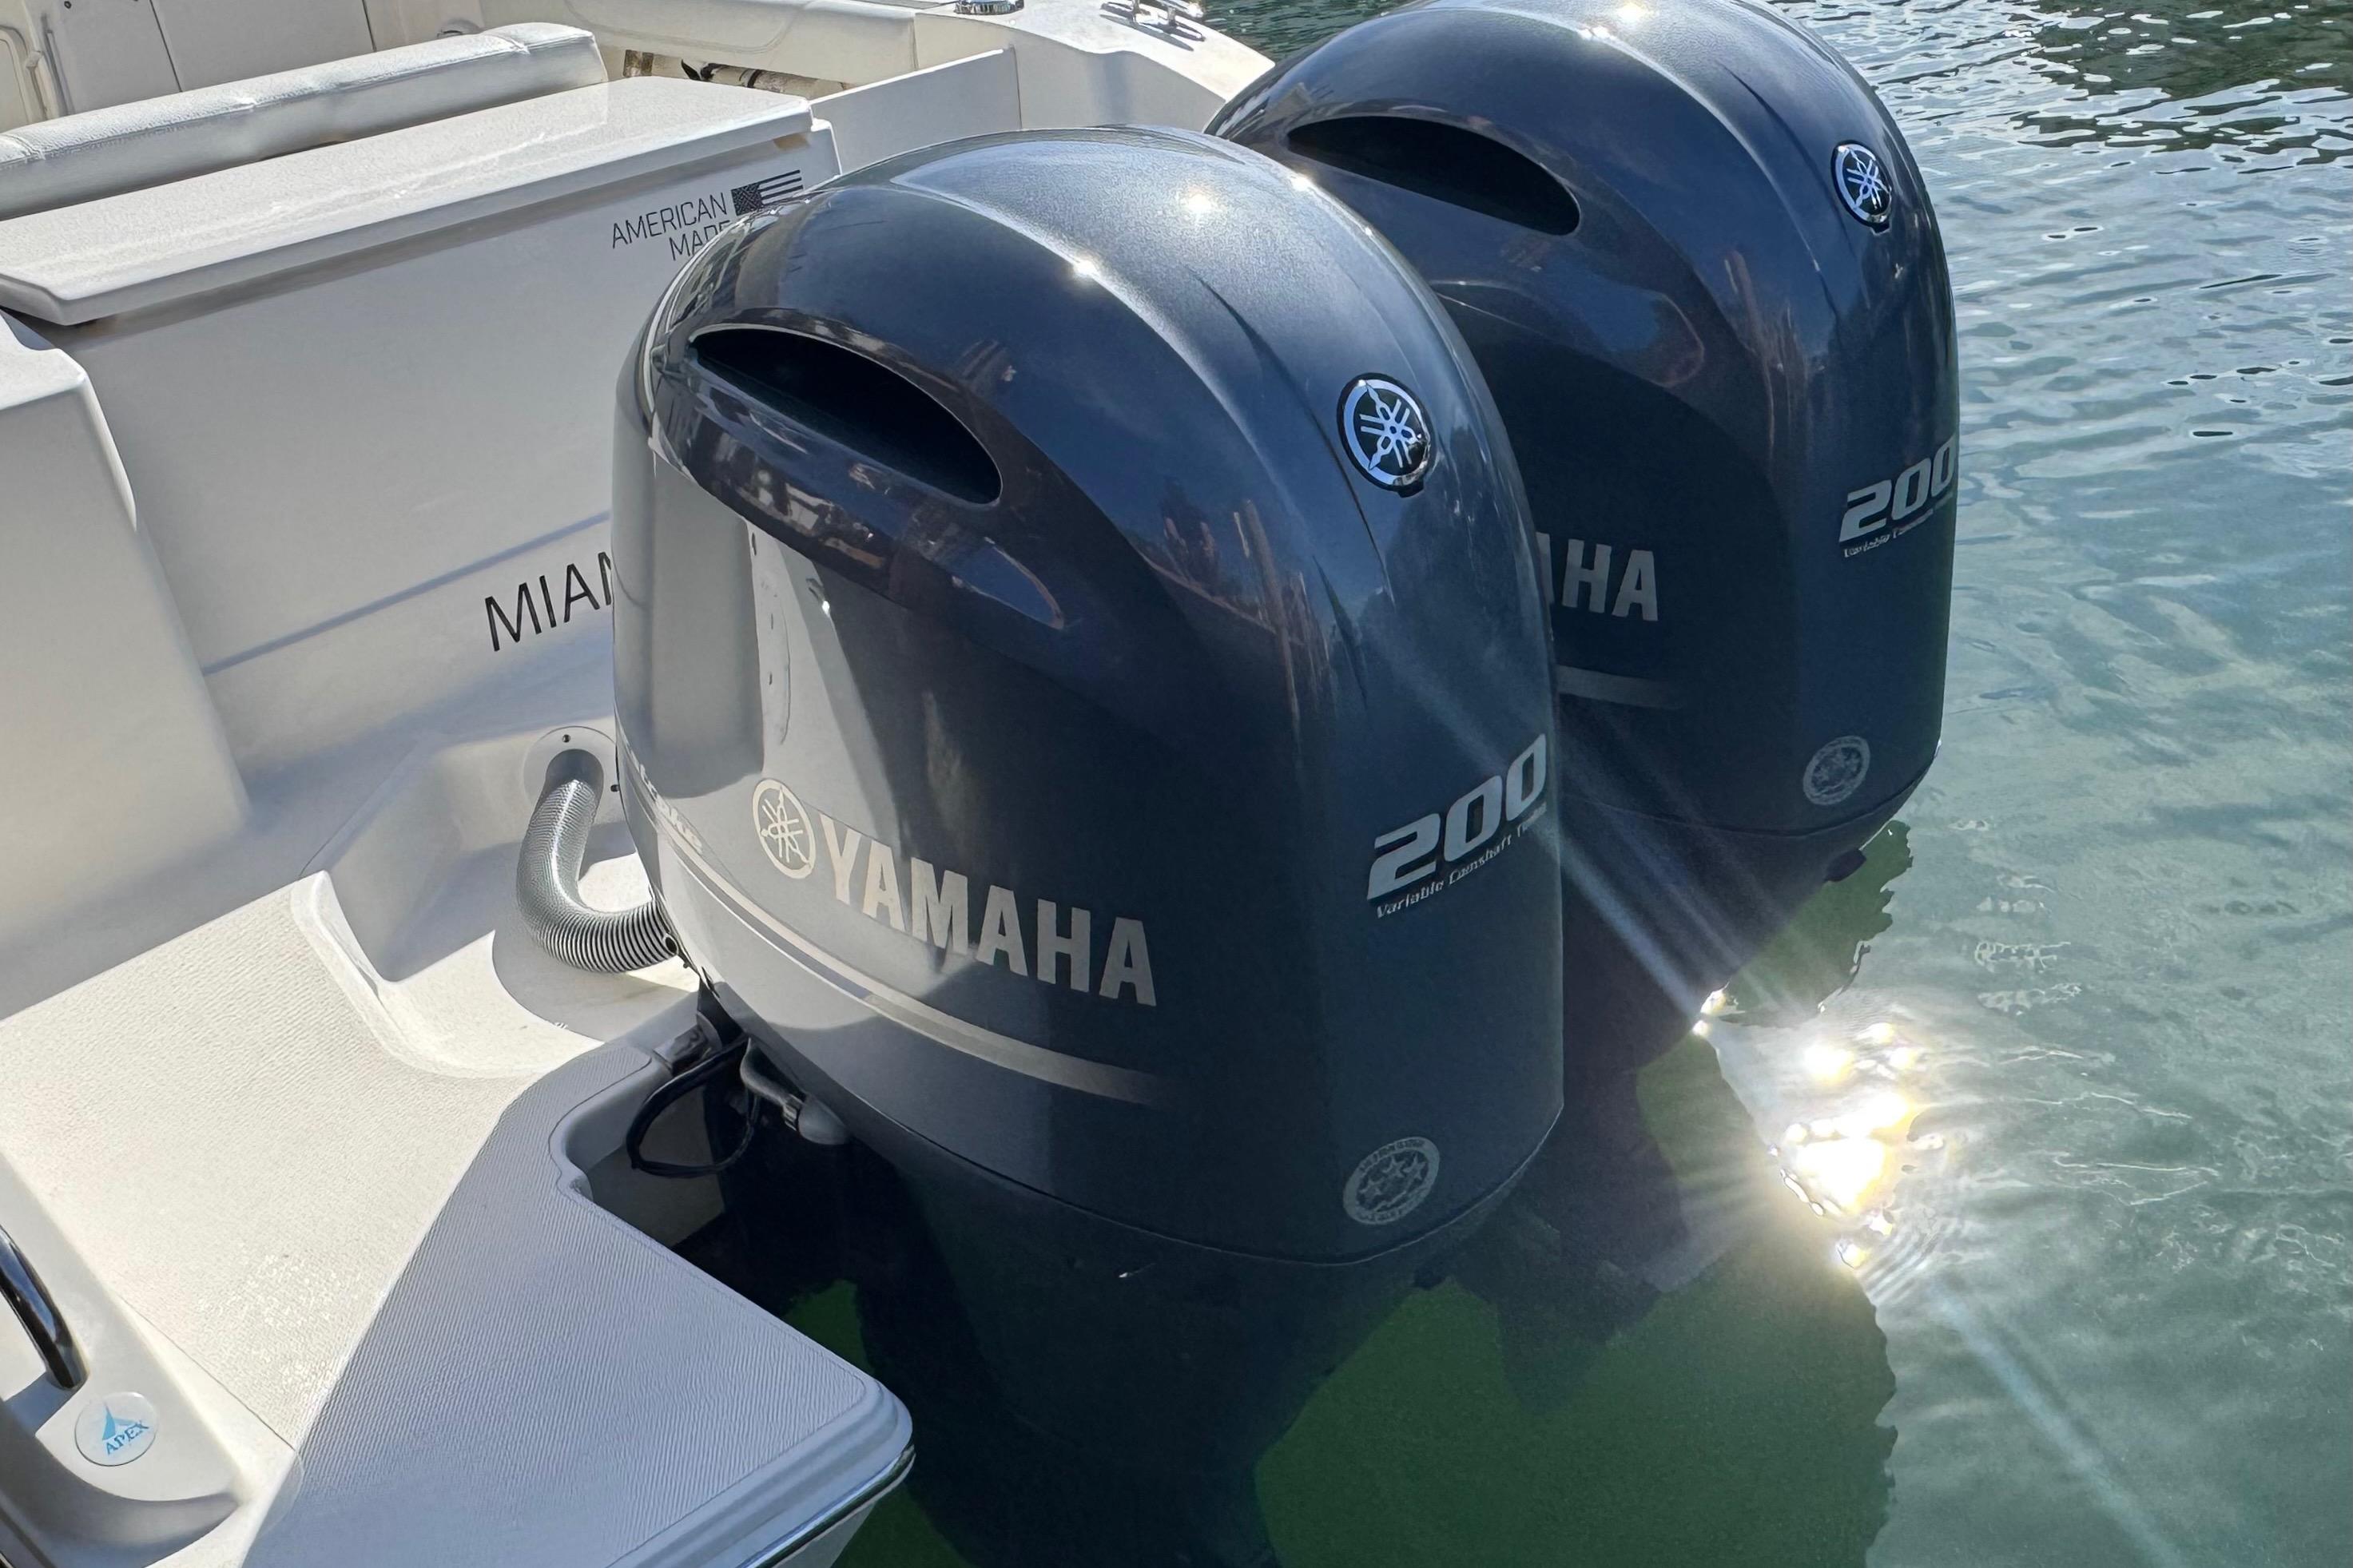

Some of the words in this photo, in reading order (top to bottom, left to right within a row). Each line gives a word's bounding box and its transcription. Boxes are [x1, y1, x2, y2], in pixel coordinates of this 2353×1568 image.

[612, 192, 727, 248] AMERICAN
[1838, 431, 1957, 543] 200
[1367, 733, 1546, 900] 200
[820, 813, 1156, 1006] YAMAHA
[1377, 879, 1444, 919] Variable
[105, 1419, 149, 1455] APEX
